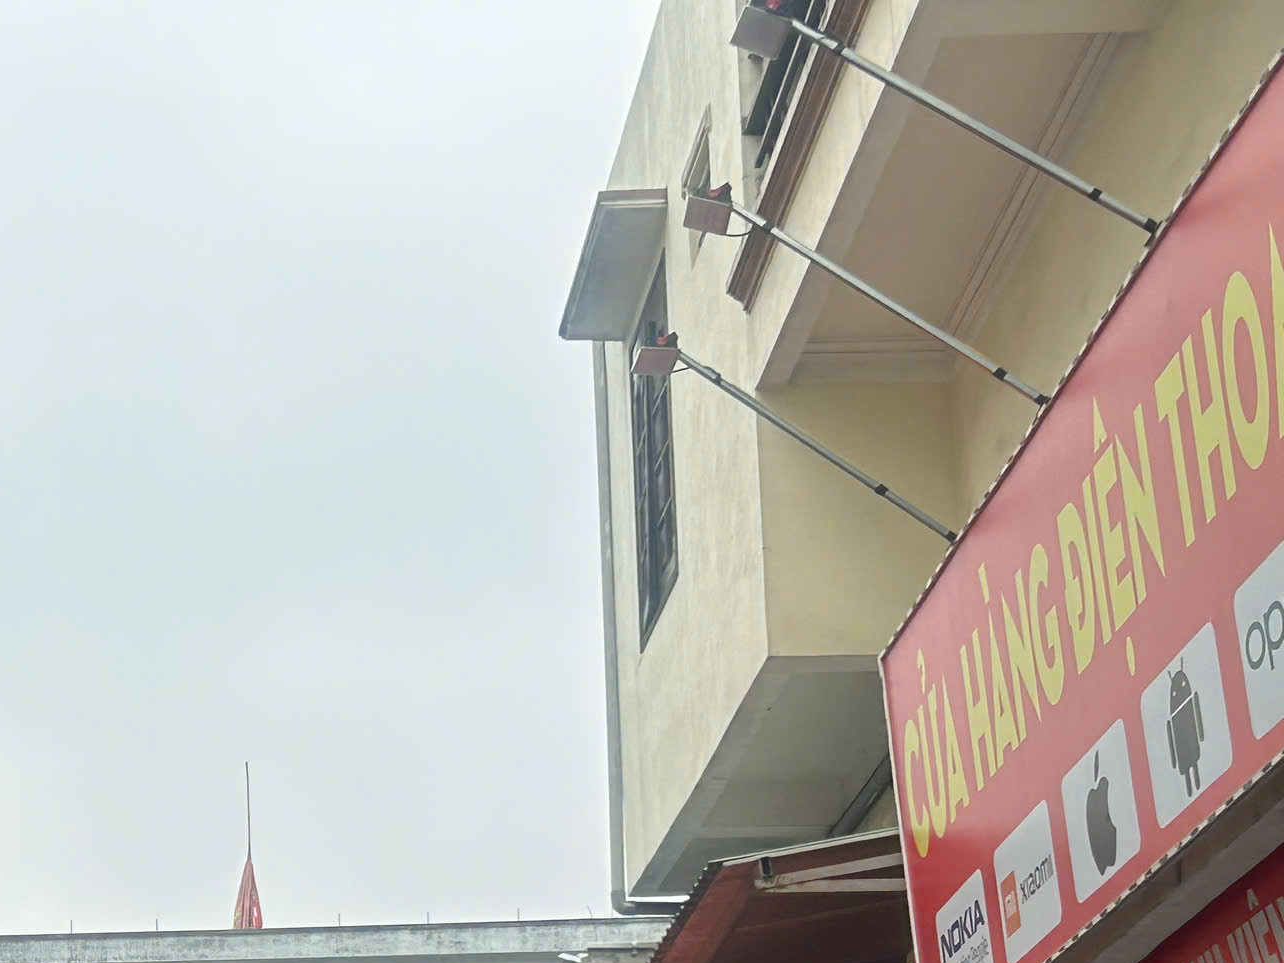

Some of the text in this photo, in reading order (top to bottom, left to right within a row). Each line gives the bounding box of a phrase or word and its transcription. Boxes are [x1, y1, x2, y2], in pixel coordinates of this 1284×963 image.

[960, 543, 1064, 791] HÀNG
[1056, 395, 1166, 677] ĐIỆN
[1154, 222, 1284, 547] THO
[940, 899, 985, 963] NOKIA
